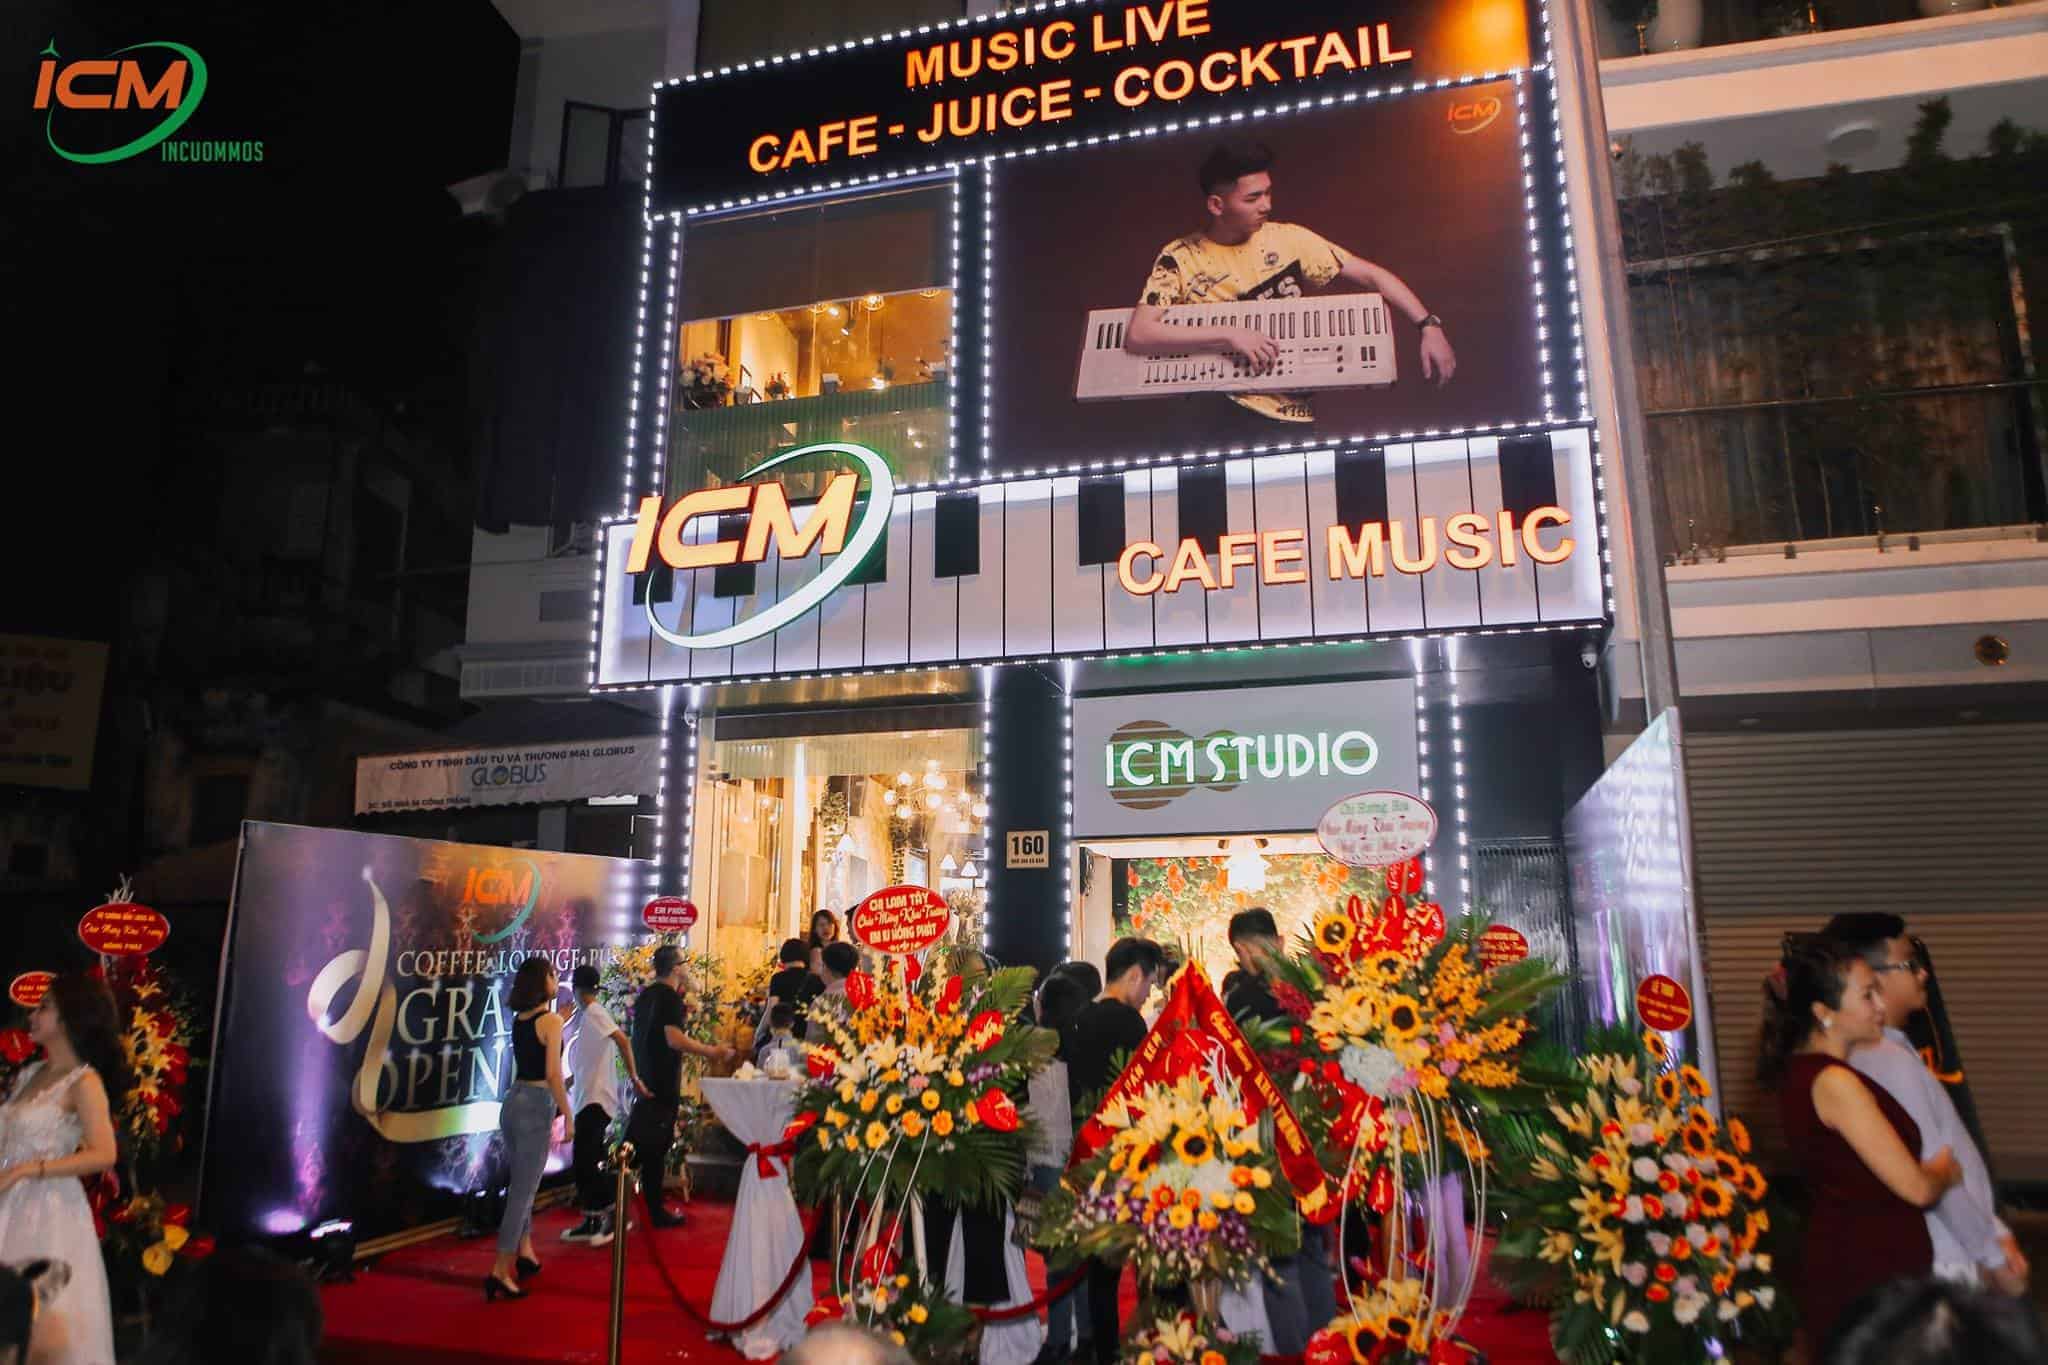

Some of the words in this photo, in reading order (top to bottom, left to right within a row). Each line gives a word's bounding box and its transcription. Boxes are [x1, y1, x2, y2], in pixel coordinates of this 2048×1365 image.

[905, 20, 1076, 88] MUSIC
[1092, 0, 1211, 55] LIVE
[748, 115, 879, 174] CAFE
[917, 79, 1074, 144] JUICE
[1112, 23, 1413, 108] COCKTAIL
[624, 472, 861, 575] ICM
[1117, 528, 1307, 596] CAFE
[1326, 505, 1577, 580] MUSIC
[1105, 739, 1195, 787] ICM
[1205, 730, 1379, 783] STUDIO
[1011, 835, 1045, 856] 160
[396, 949, 488, 978] COFFEE
